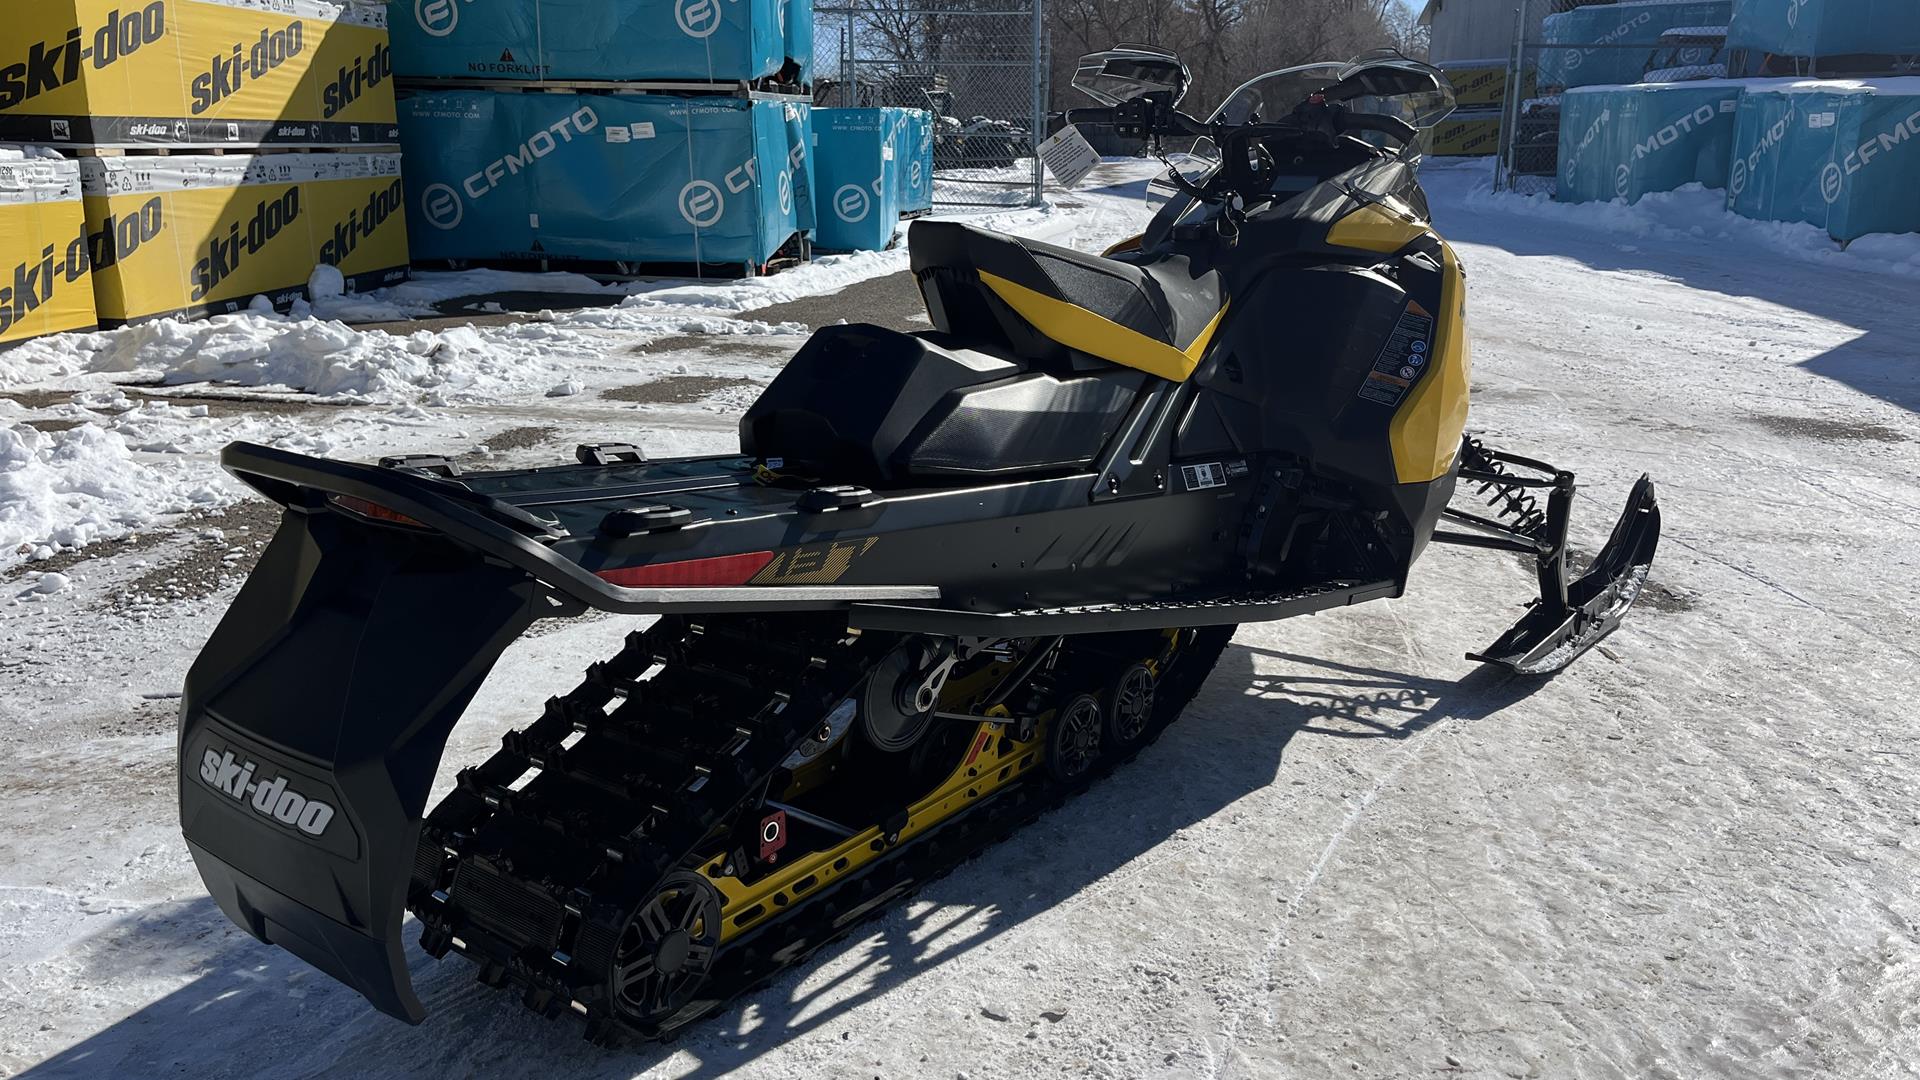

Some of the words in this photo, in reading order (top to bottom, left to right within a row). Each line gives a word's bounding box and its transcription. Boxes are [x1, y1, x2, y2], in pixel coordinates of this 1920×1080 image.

[0, 1, 164, 110] ski-doo
[191, 20, 303, 115] ski-doo
[468, 62, 486, 72] NO
[490, 62, 551, 75] FORKLIFT
[130, 124, 168, 136] ski-doo
[278, 126, 306, 137] ski-doo
[463, 106, 599, 199] CFMOTO
[1631, 104, 1715, 161] MOTO
[191, 186, 299, 302] ski-doo
[319, 178, 401, 267] ski-doo
[200, 749, 336, 836] ski-doo
